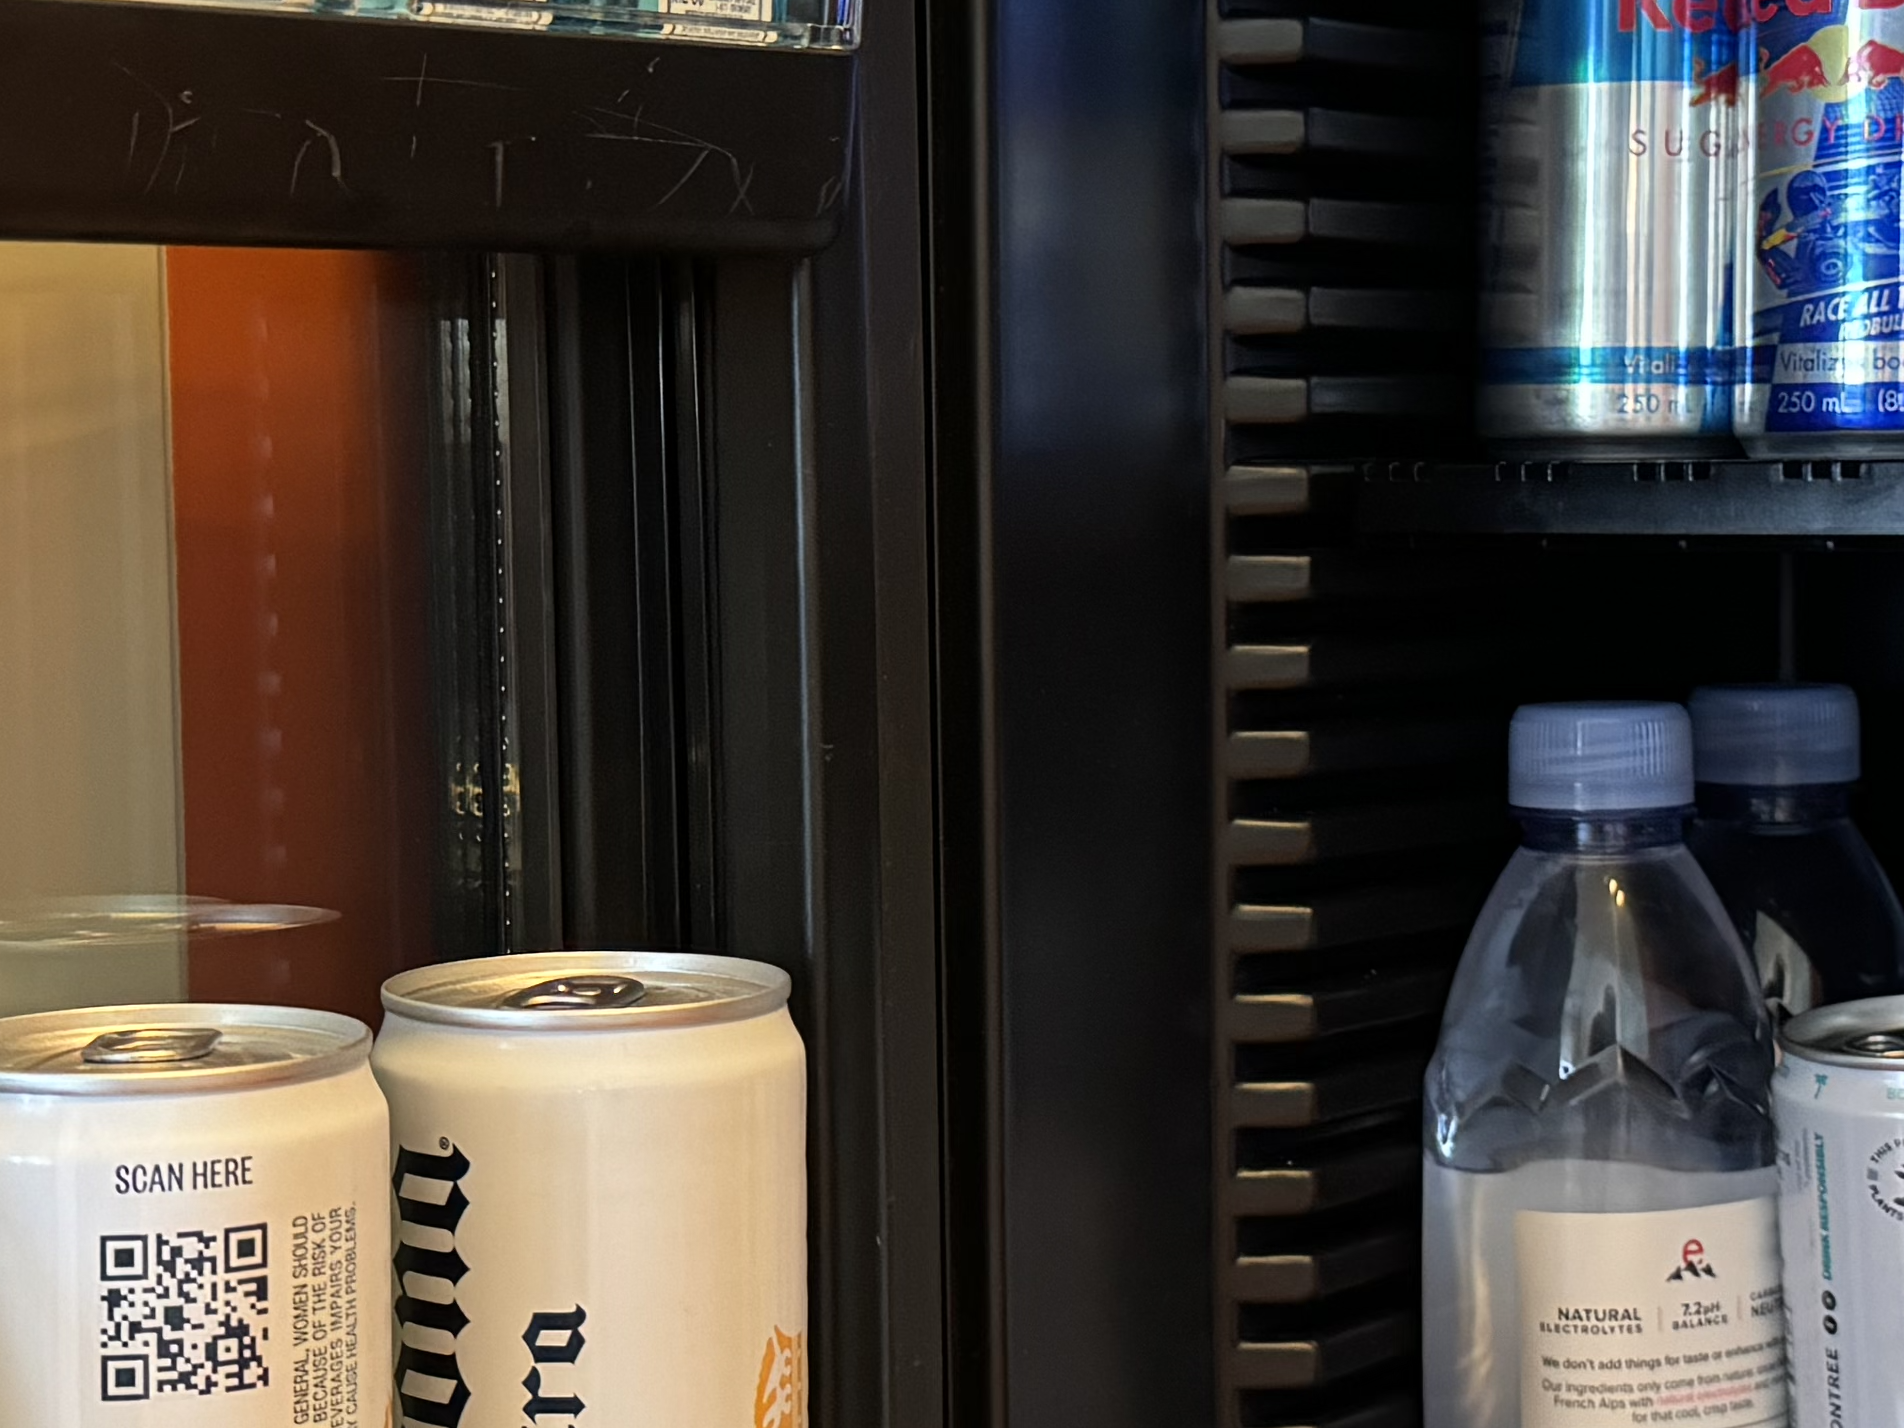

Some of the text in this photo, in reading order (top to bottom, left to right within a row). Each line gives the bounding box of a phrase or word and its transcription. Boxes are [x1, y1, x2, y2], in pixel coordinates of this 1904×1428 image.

[1778, 391, 1815, 413] 250
[114, 1155, 253, 1194] SCAN HERE
[1557, 1307, 1642, 1322] NATURAL
[1672, 1314, 1729, 1331] BALANCE
[1539, 1323, 1643, 1335] ELECTROLYTES
[1542, 1356, 1661, 1372] We don't add things
